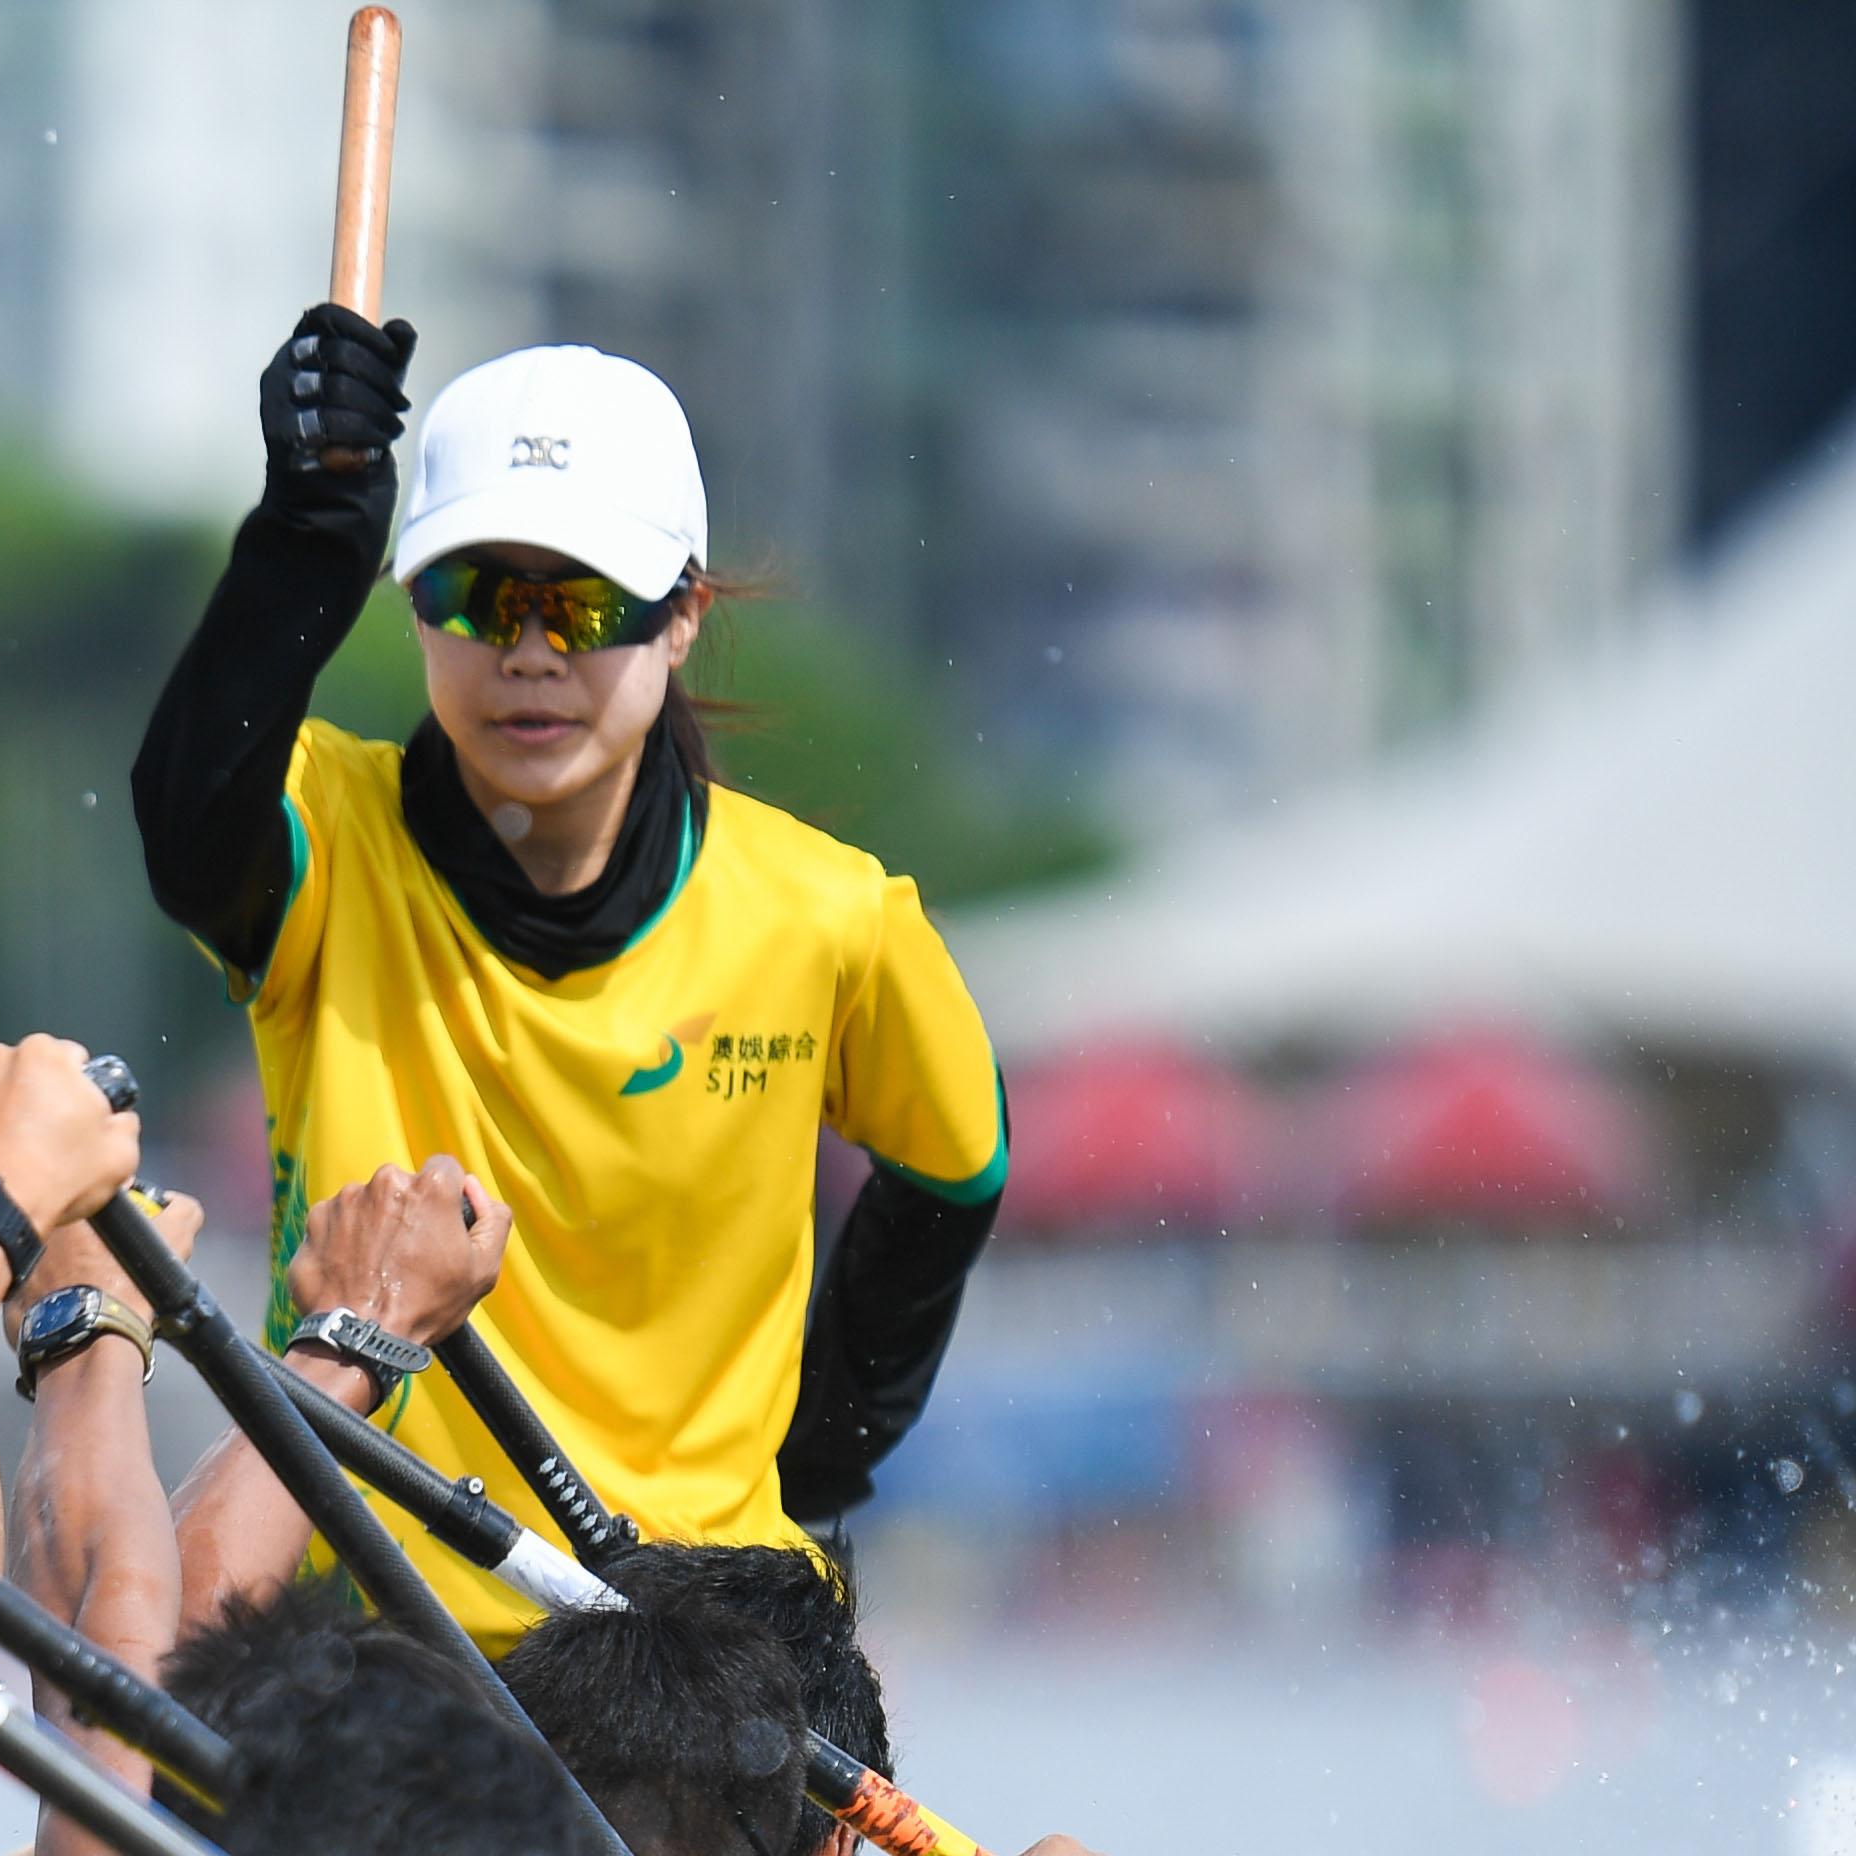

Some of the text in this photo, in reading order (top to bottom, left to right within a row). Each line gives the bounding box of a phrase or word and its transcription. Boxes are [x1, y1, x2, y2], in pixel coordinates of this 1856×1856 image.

[711, 1031, 817, 1063] 澳娛綜合
[706, 1067, 767, 1101] SJM
